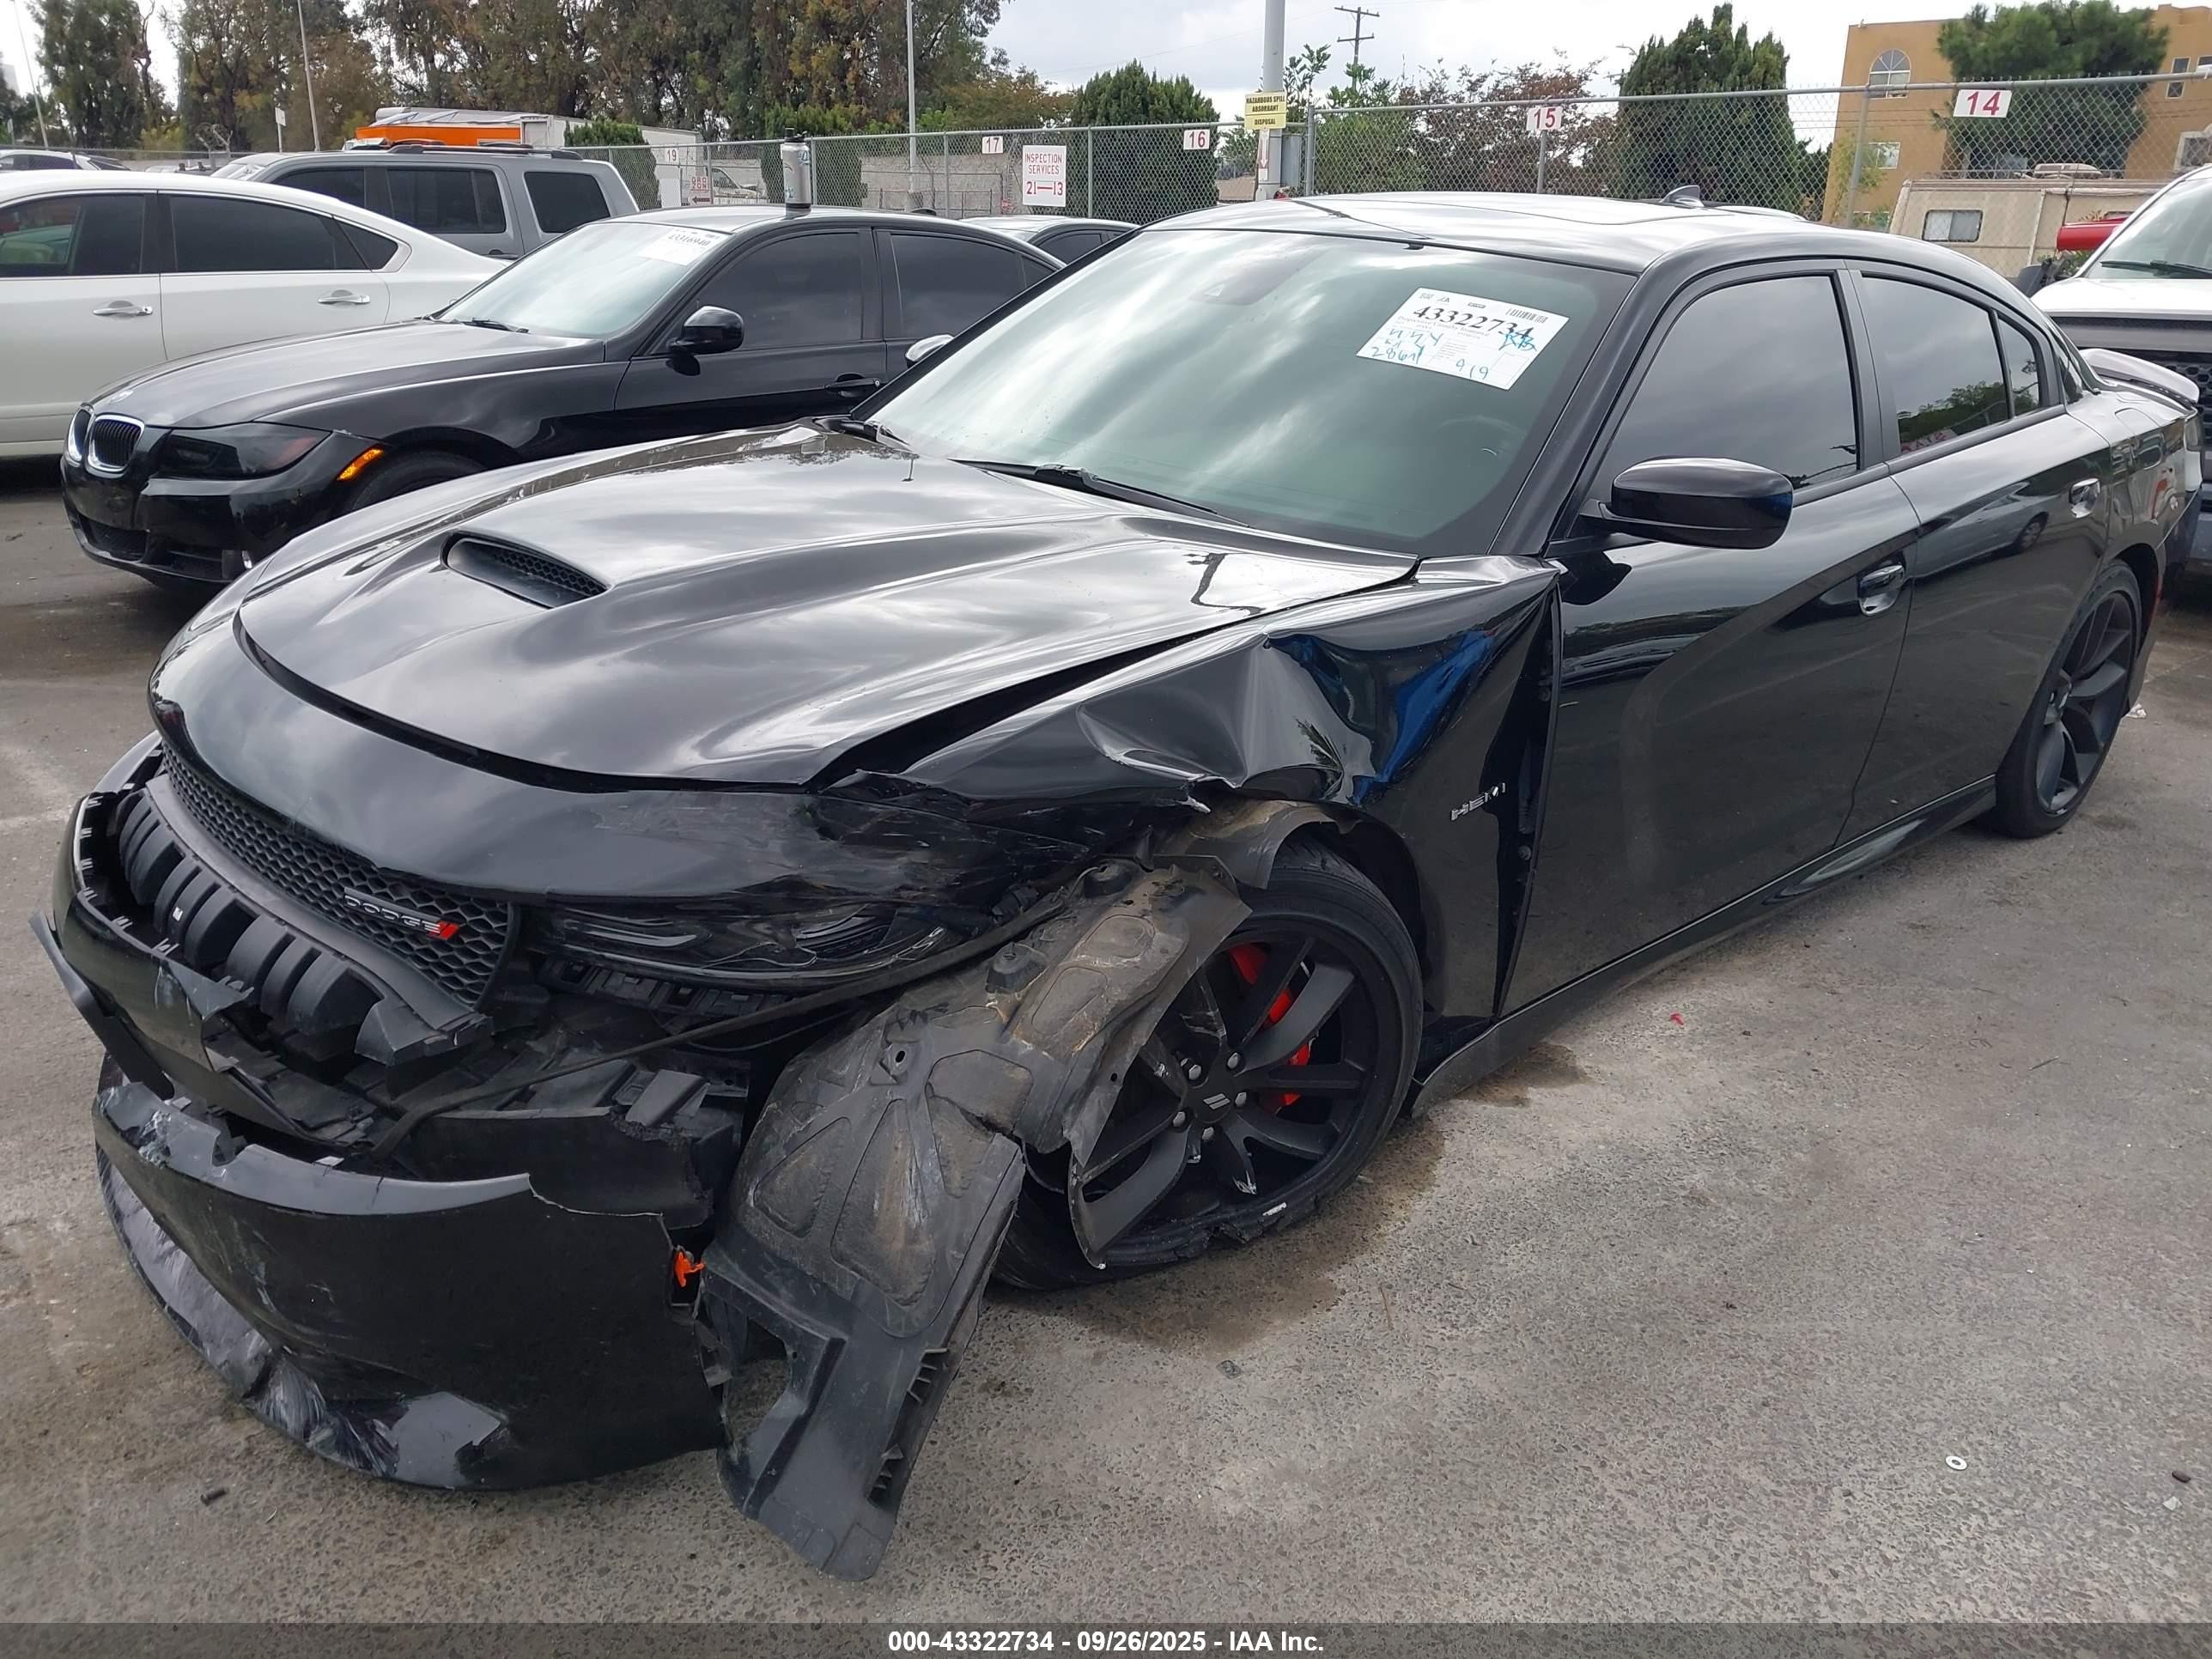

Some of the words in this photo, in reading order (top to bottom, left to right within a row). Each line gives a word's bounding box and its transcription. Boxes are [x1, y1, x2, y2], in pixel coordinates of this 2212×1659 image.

[1966, 91, 2001, 116] 14
[1534, 107, 1556, 129] 15
[986, 137, 1000, 152] 17
[1188, 131, 1206, 149] 16
[666, 149, 677, 161] 19
[1024, 153, 1063, 164] INSPECTION
[1028, 164, 1060, 175] SERVICES
[1413, 306, 1534, 340] 43322734
[1450, 782, 1506, 821] HEMI
[344, 895, 441, 934] DODGE
